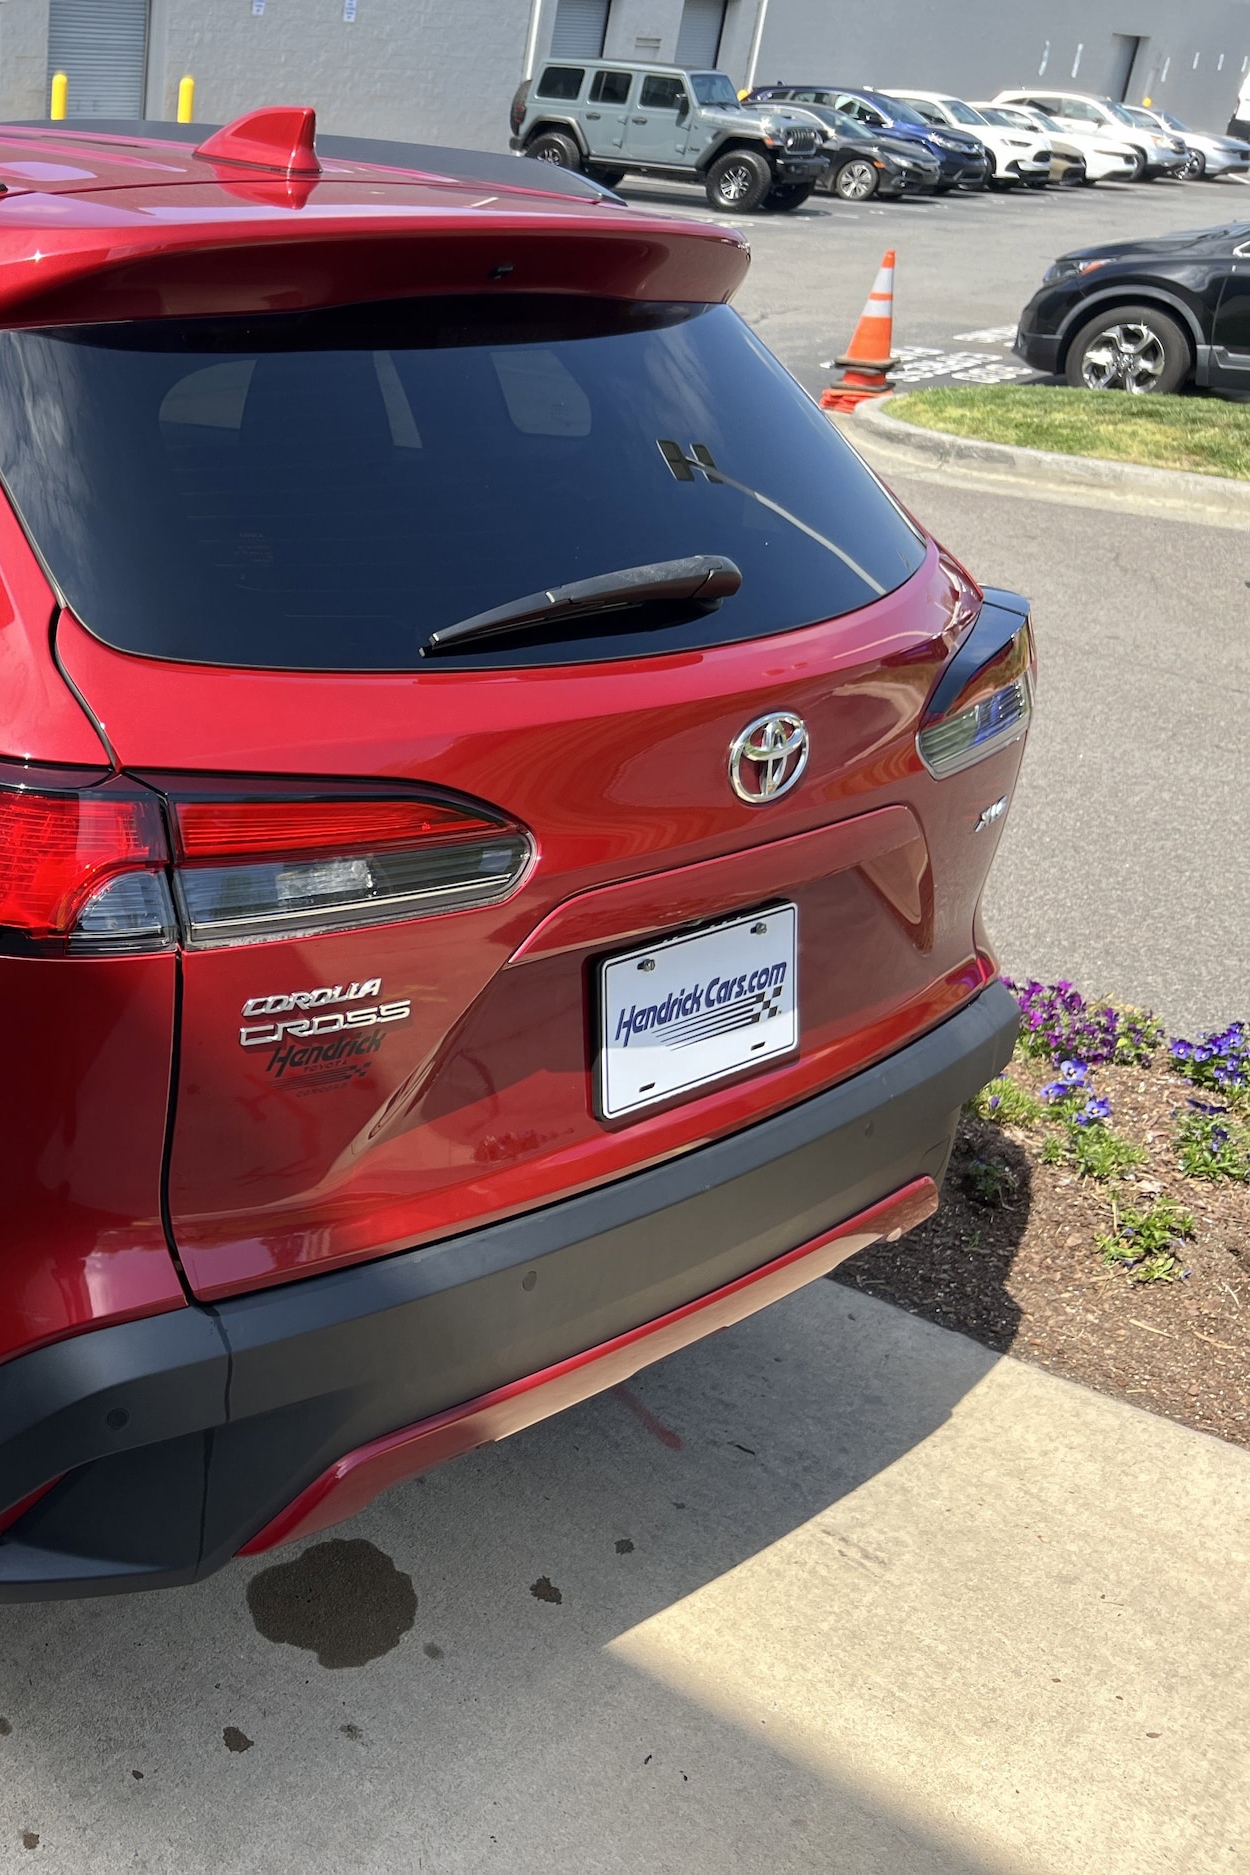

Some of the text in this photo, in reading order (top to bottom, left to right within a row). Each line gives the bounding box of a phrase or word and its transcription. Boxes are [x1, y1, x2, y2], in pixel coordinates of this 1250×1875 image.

[240, 977, 382, 1017] COROLLA
[239, 999, 412, 1047] CROSS
[265, 1028, 388, 1079] Hendrick
